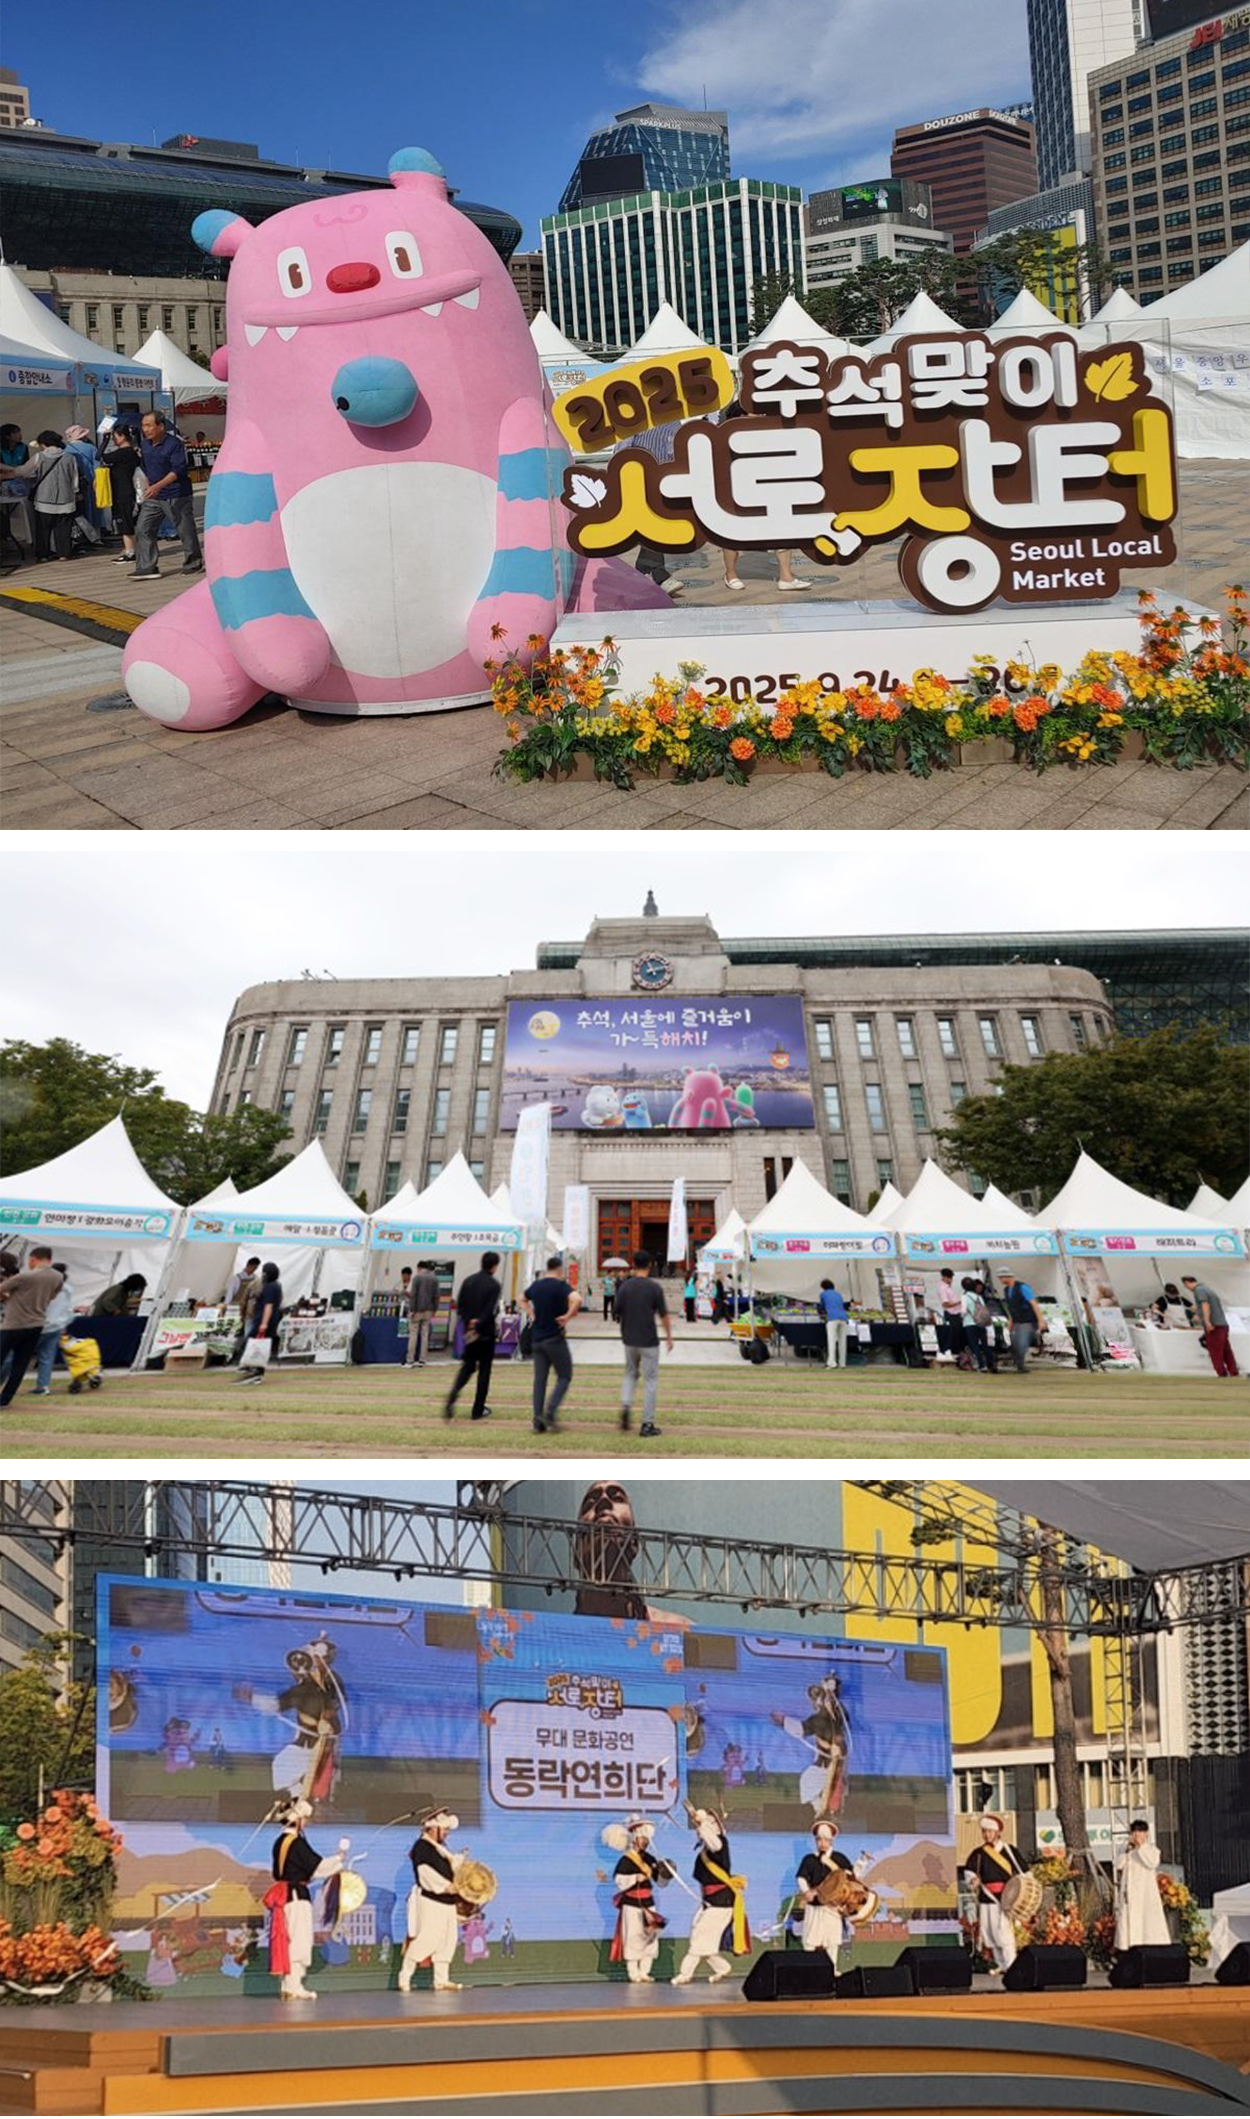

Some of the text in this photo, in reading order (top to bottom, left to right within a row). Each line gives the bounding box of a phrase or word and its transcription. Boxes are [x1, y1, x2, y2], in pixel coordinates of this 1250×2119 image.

[640, 118, 682, 129] SPARKPLUS
[924, 110, 980, 131] DOUZONE
[18, 370, 53, 385] 종합안내소
[751, 340, 1080, 430] 추석맞이
[565, 356, 718, 448] 2025
[578, 407, 1175, 607] 서로장터
[1010, 534, 1163, 562] Seoul Local
[1012, 567, 1106, 591] Market
[576, 1007, 752, 1029] 추석, 서울에 즐거움이
[536, 1728, 634, 1752] 무대 문화공연
[503, 1756, 667, 1801] 동락연희단
